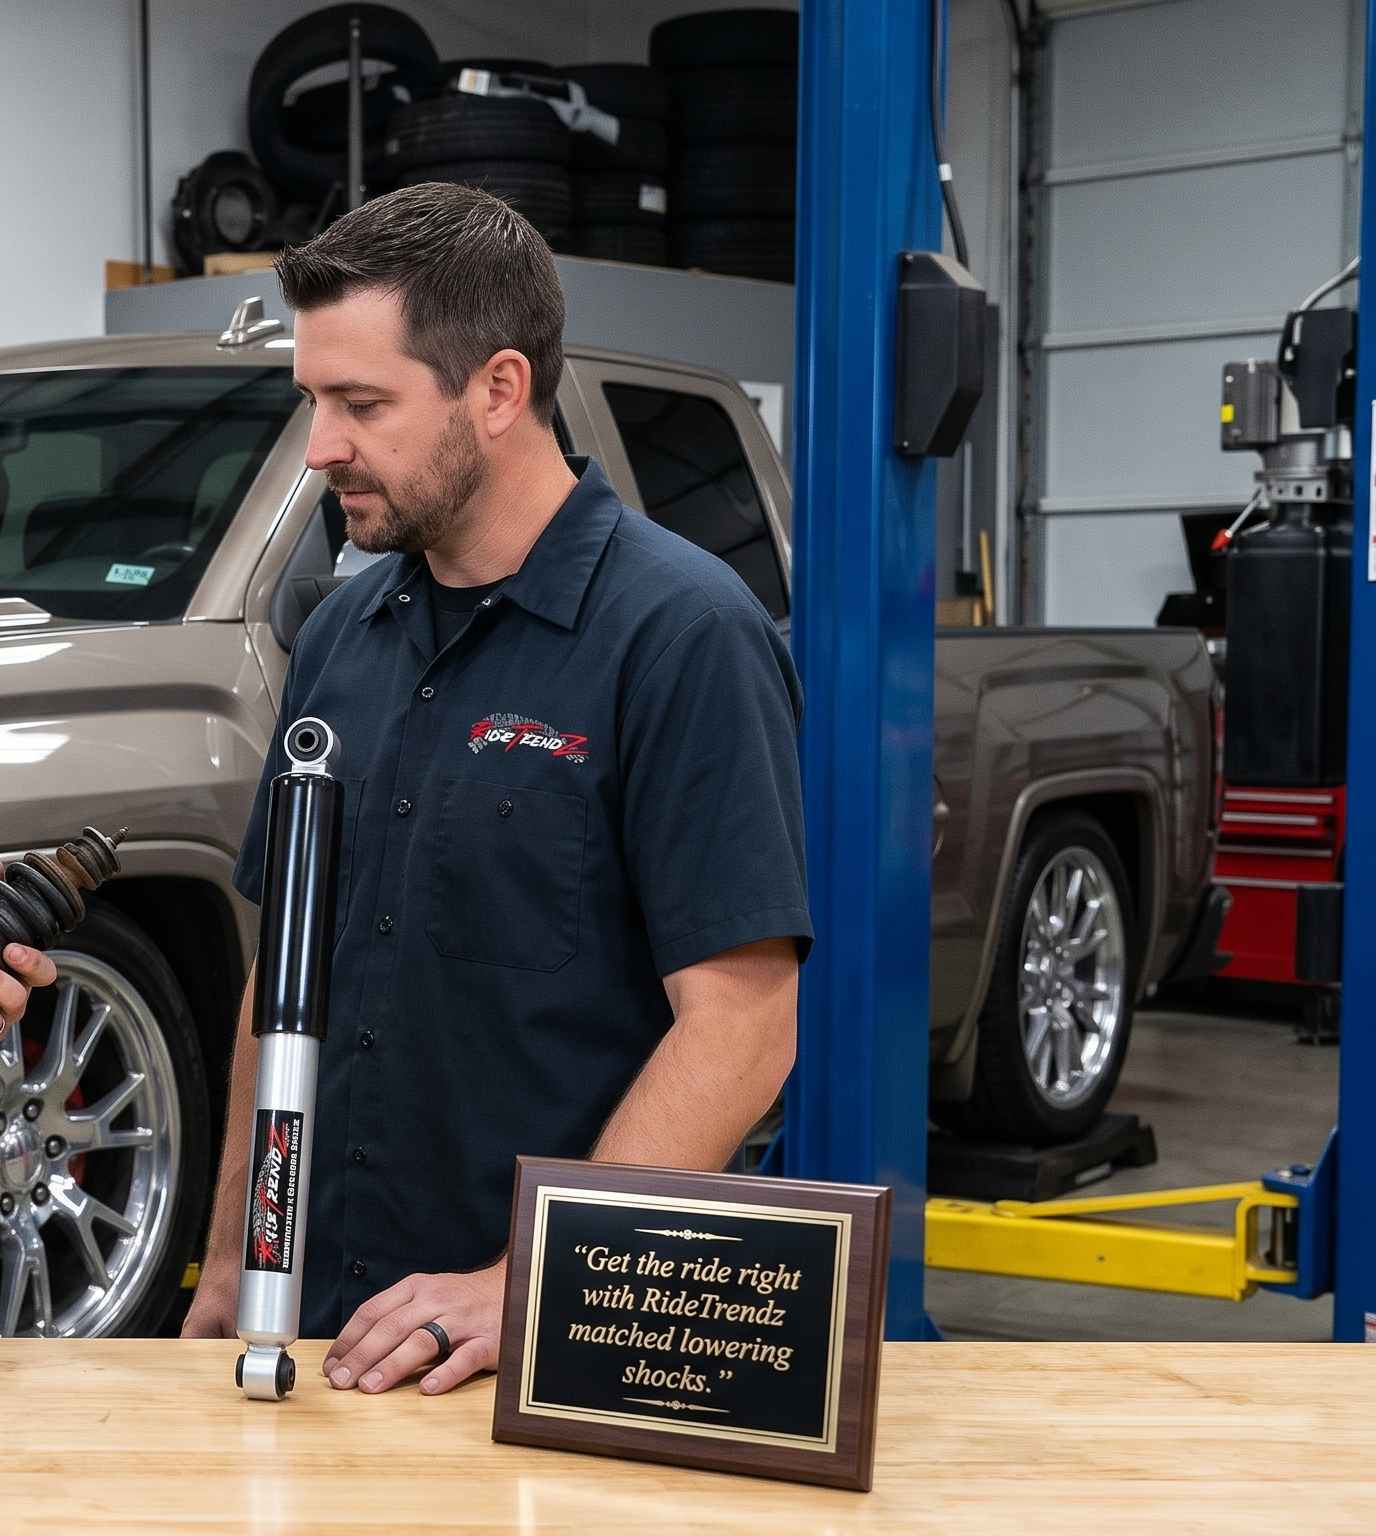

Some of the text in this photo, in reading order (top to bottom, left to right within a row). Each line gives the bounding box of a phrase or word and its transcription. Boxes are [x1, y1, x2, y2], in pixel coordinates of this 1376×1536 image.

[575, 1245, 801, 1293] “Get the ride right
[583, 1285, 785, 1326] with RideTrendz
[569, 1322, 793, 1370] matched lowering
